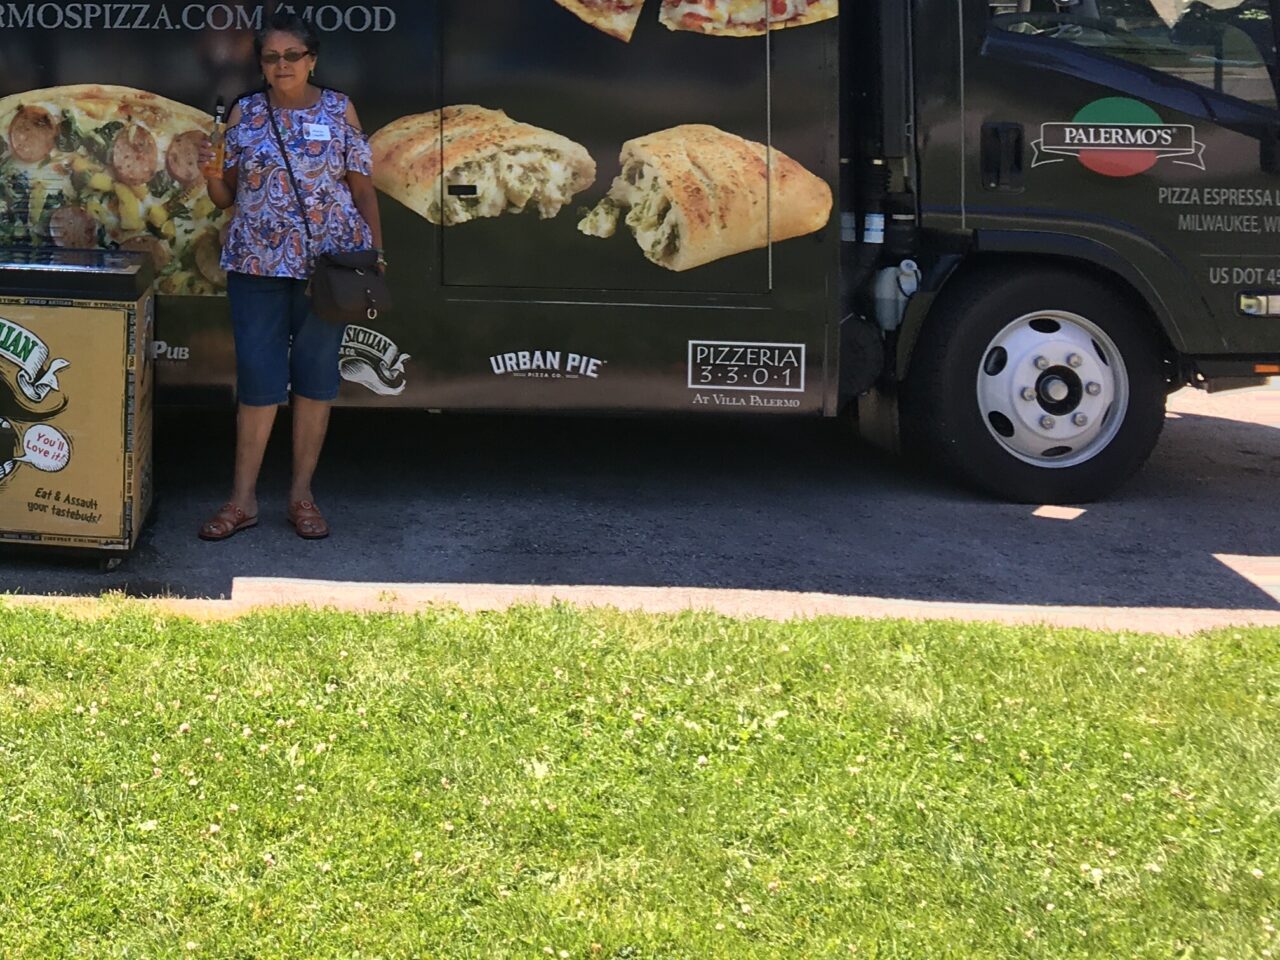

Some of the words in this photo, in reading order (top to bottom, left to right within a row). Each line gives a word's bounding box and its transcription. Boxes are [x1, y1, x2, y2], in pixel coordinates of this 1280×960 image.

[1158, 187, 1200, 204] PIZZA
[1204, 189, 1273, 206] ESPRESSA
[1178, 214, 1261, 233] MILWAUKEE,
[1264, 216, 1280, 232] WI
[1209, 267, 1229, 284] US
[1233, 268, 1264, 284] DOT
[345, 326, 392, 357] SICILIAN
[490, 350, 561, 375] URBAN
[566, 352, 603, 379] PIE
[696, 346, 799, 367] PIZZERIA
[26, 439, 50, 458] Love
[50, 450, 66, 463] it!
[36, 432, 65, 452] You'll
[34, 487, 53, 500] Eat
[54, 491, 61, 502] &
[64, 493, 98, 511] Assault
[27, 501, 49, 513] your
[51, 505, 103, 524] tastebuds!
